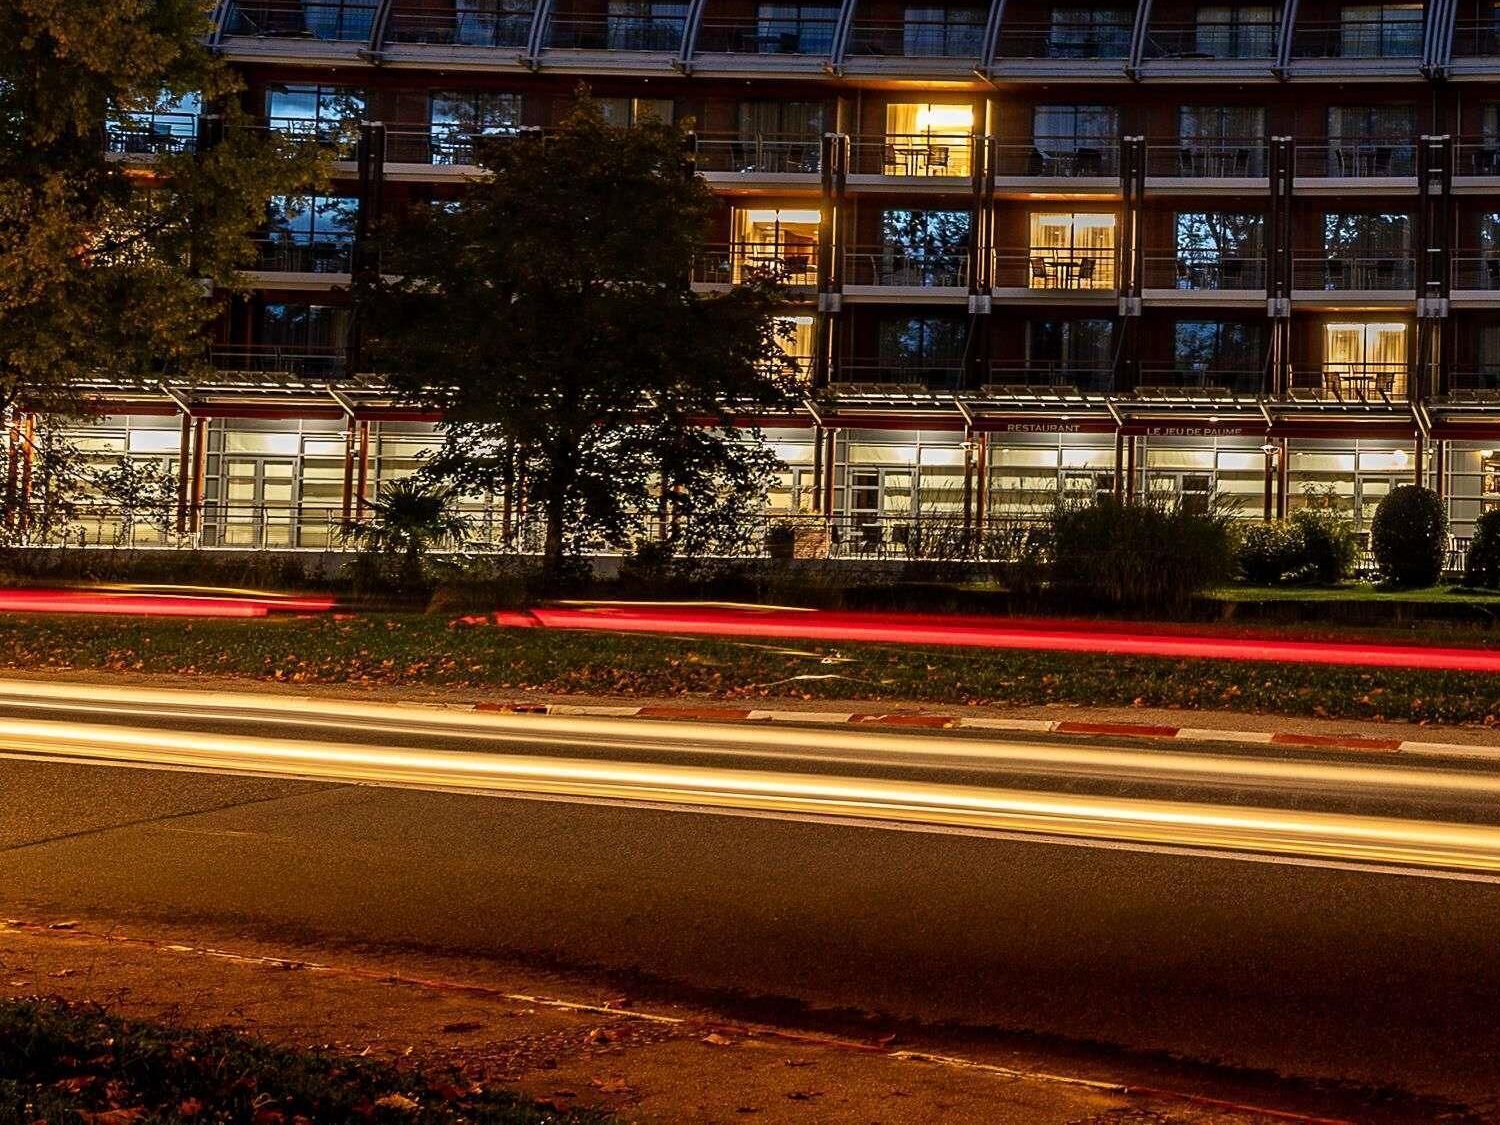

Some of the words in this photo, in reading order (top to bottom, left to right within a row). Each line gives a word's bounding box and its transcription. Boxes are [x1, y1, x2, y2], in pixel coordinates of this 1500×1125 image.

[1007, 424, 1081, 432] RESTAURANT
[1147, 427, 1161, 436] LE
[1163, 428, 1184, 436] JEU
[1186, 428, 1201, 436] DE
[1204, 428, 1243, 436] PAUME
